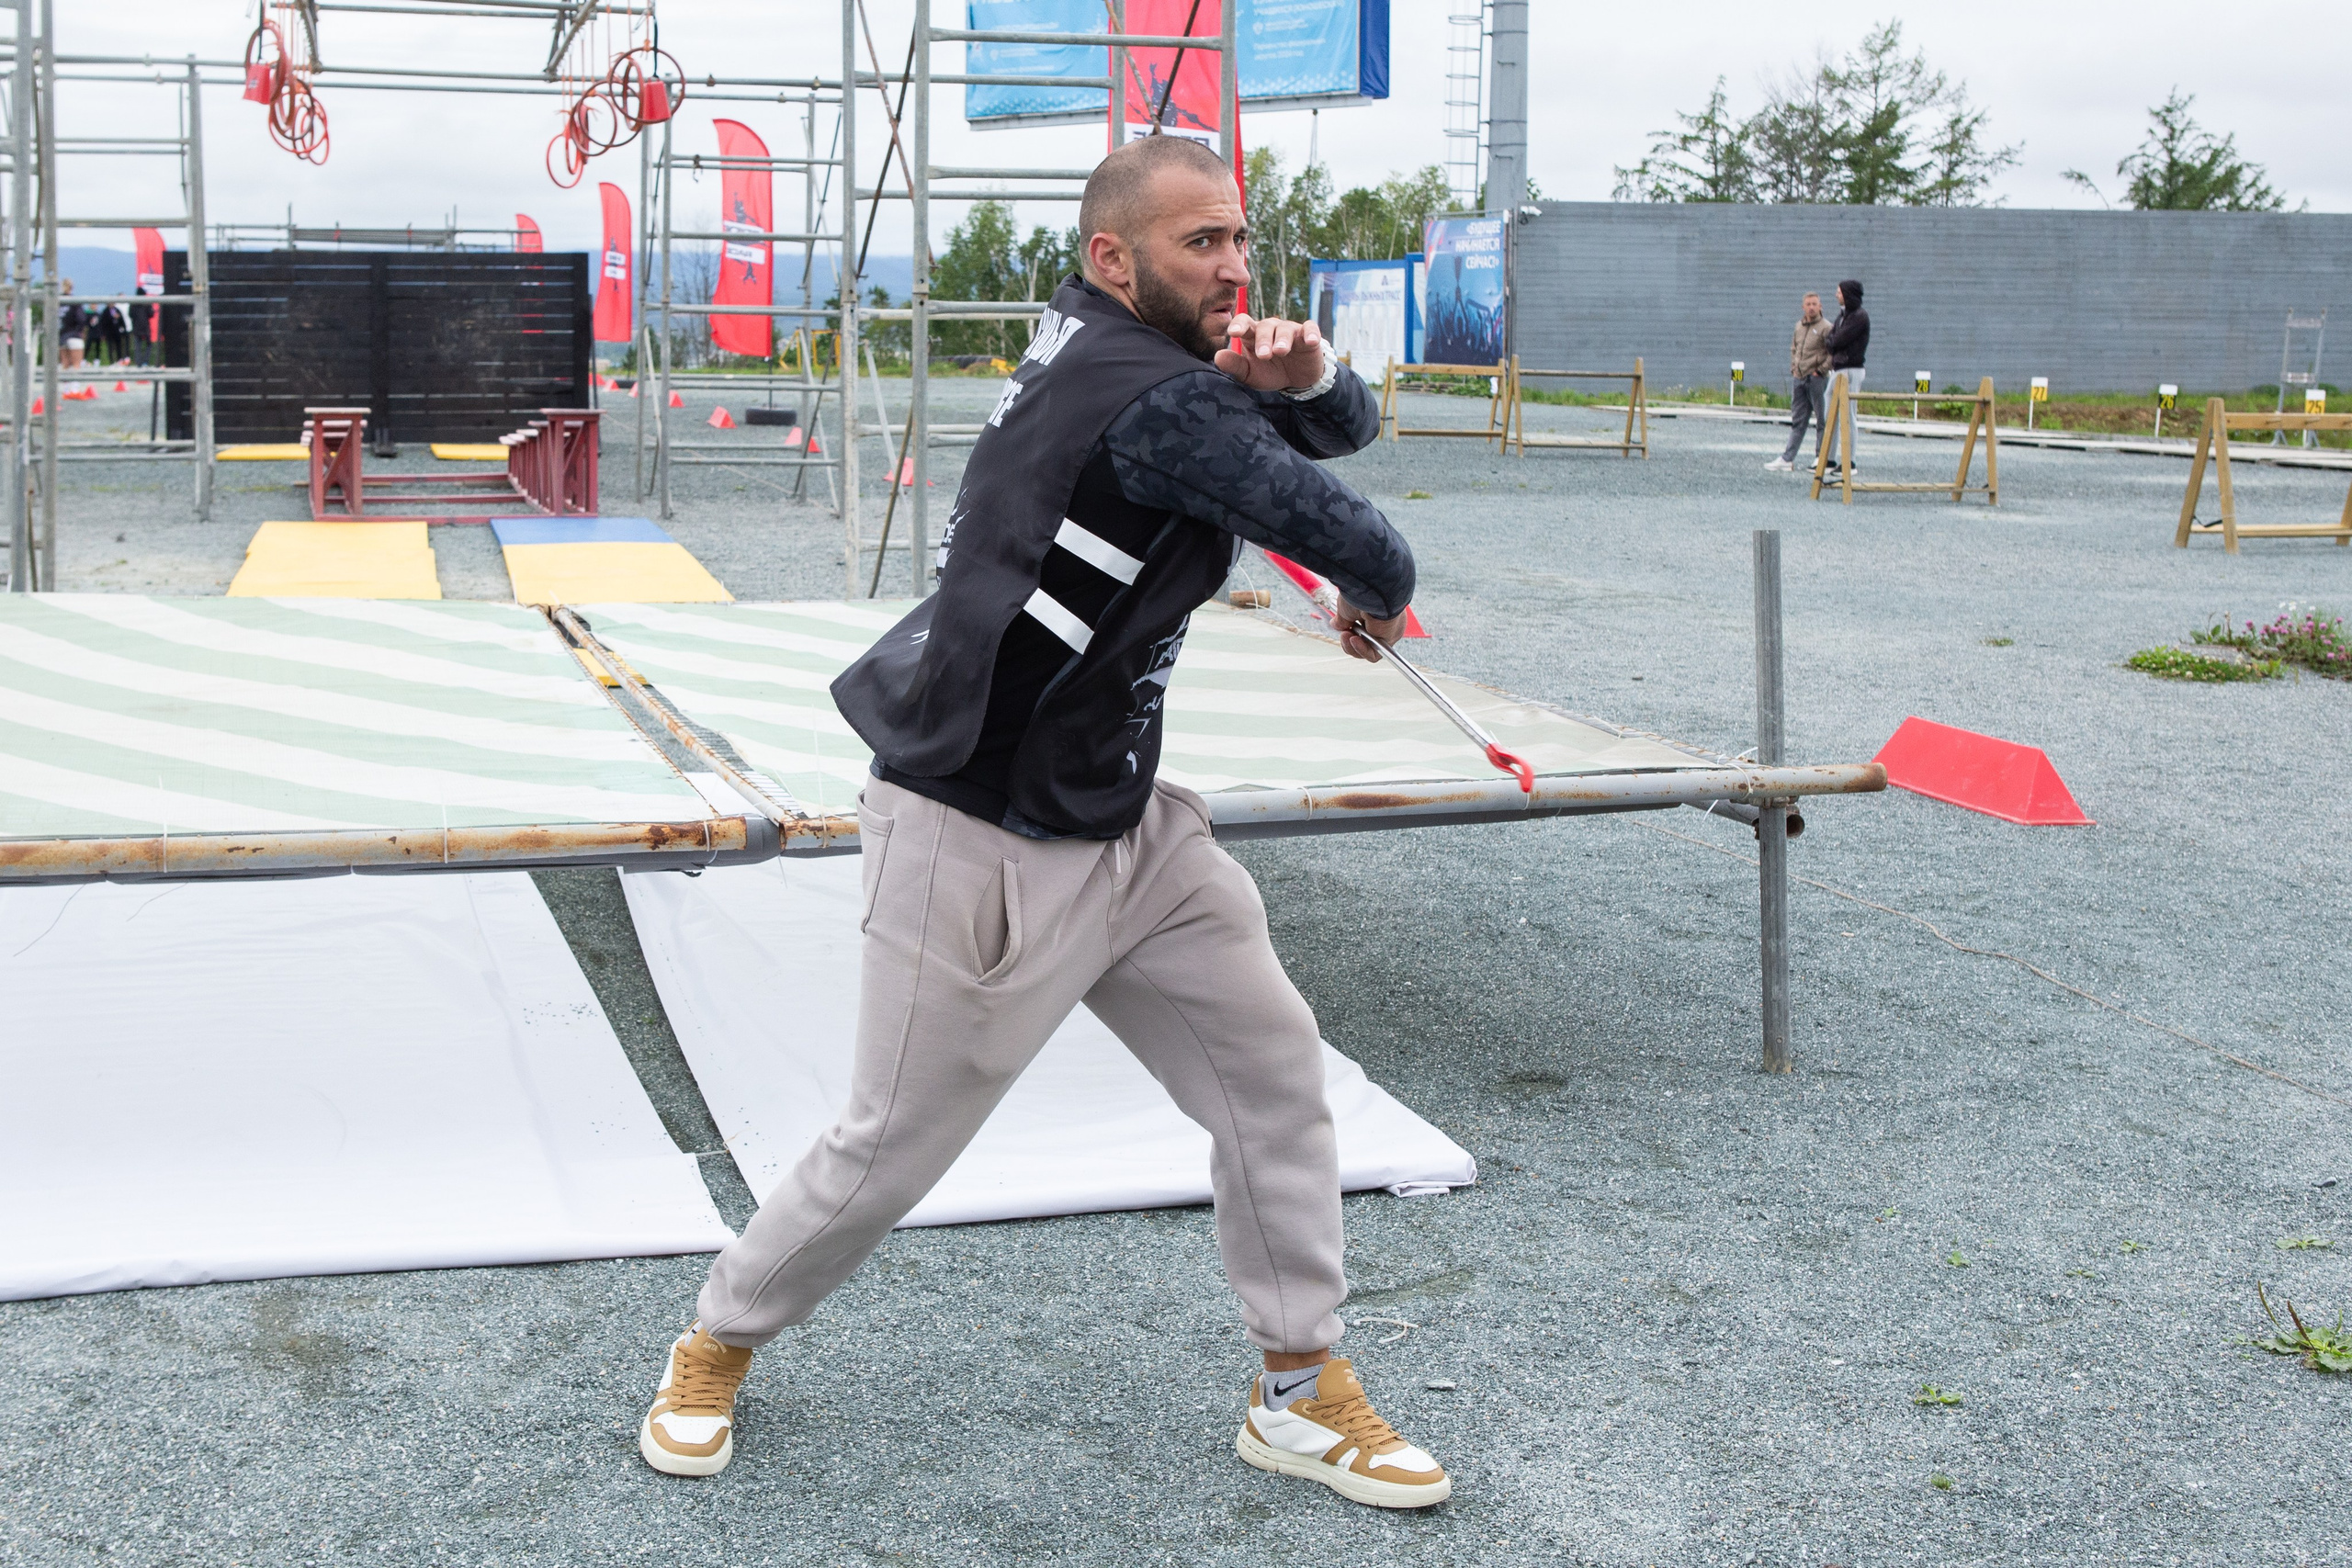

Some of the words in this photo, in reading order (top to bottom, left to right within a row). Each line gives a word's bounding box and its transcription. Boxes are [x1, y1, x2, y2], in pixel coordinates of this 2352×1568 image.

[1917, 379, 1928, 393] 28
[2033, 387, 2045, 400] 27
[2160, 394, 2175, 410] 26
[2308, 400, 2322, 413] 25
[703, 1342, 718, 1351] ANTA
